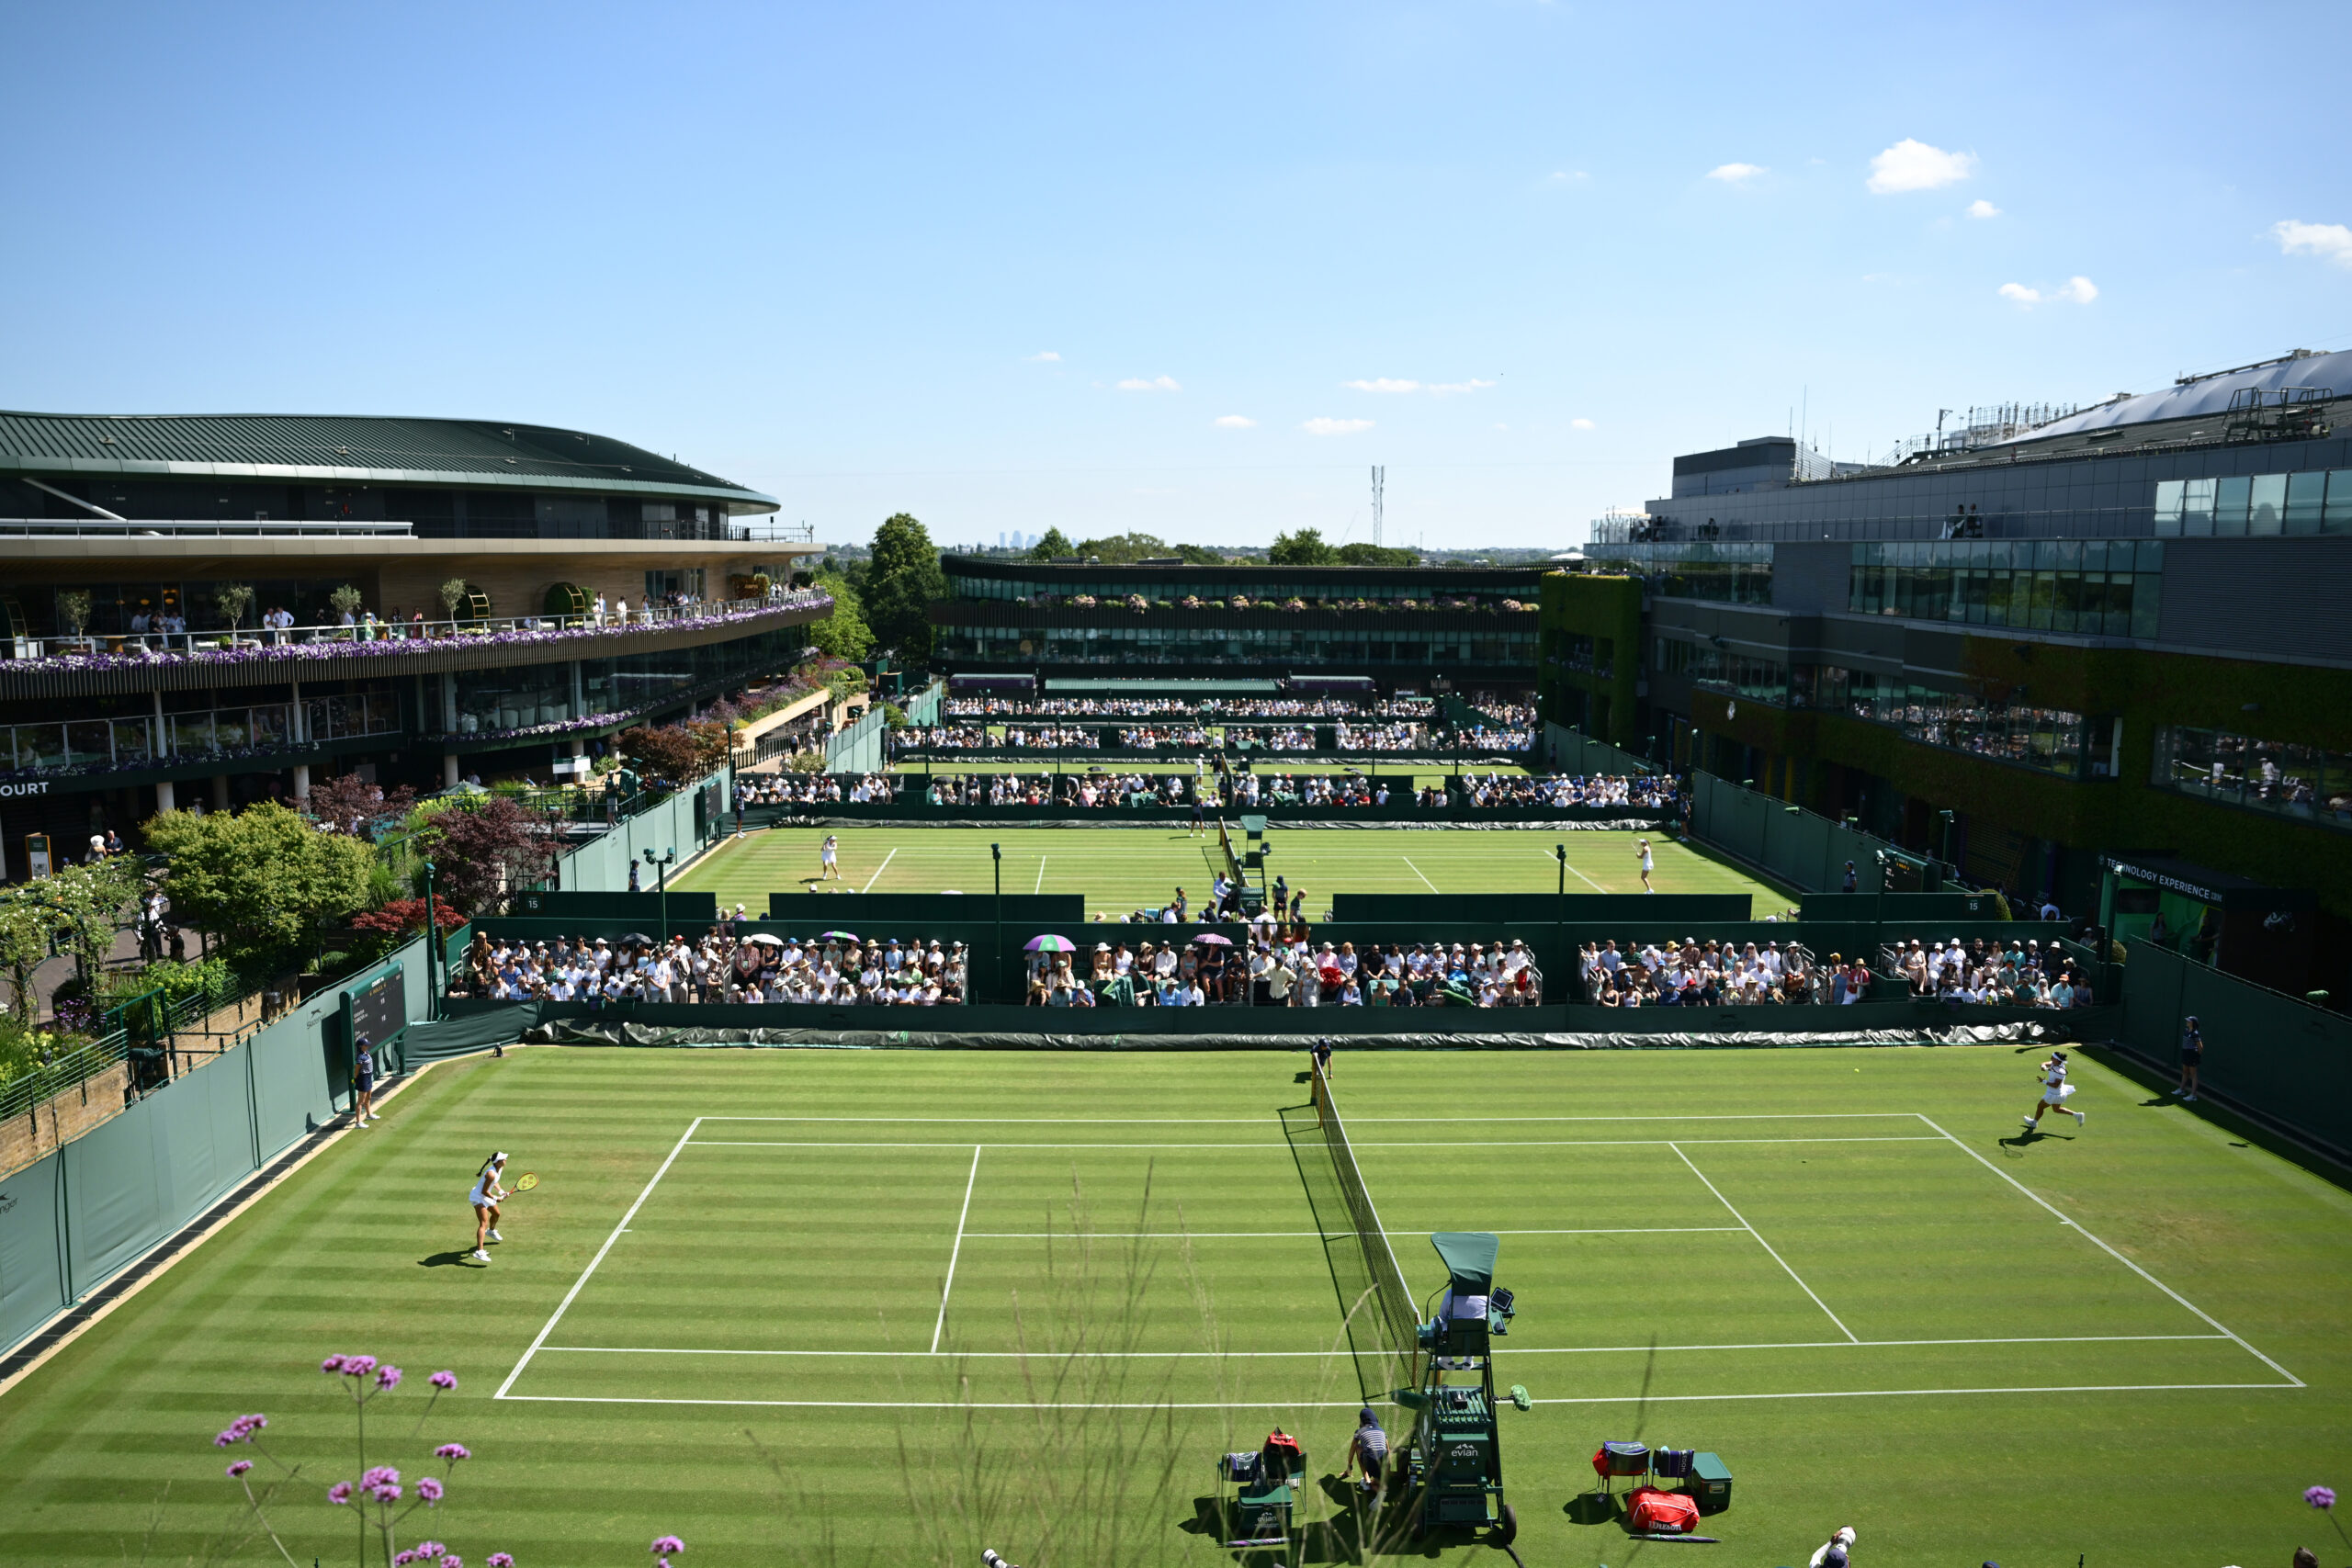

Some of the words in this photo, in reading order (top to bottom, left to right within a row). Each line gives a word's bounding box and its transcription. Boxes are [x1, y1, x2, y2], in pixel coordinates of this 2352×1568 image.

[0, 782, 50, 796] OURT
[2159, 874, 2211, 899] EXPERIENCE
[528, 900, 538, 908] 15
[1969, 902, 1978, 910] 15
[1451, 1449, 1478, 1457] evian
[1648, 1520, 1682, 1531] Wilson
